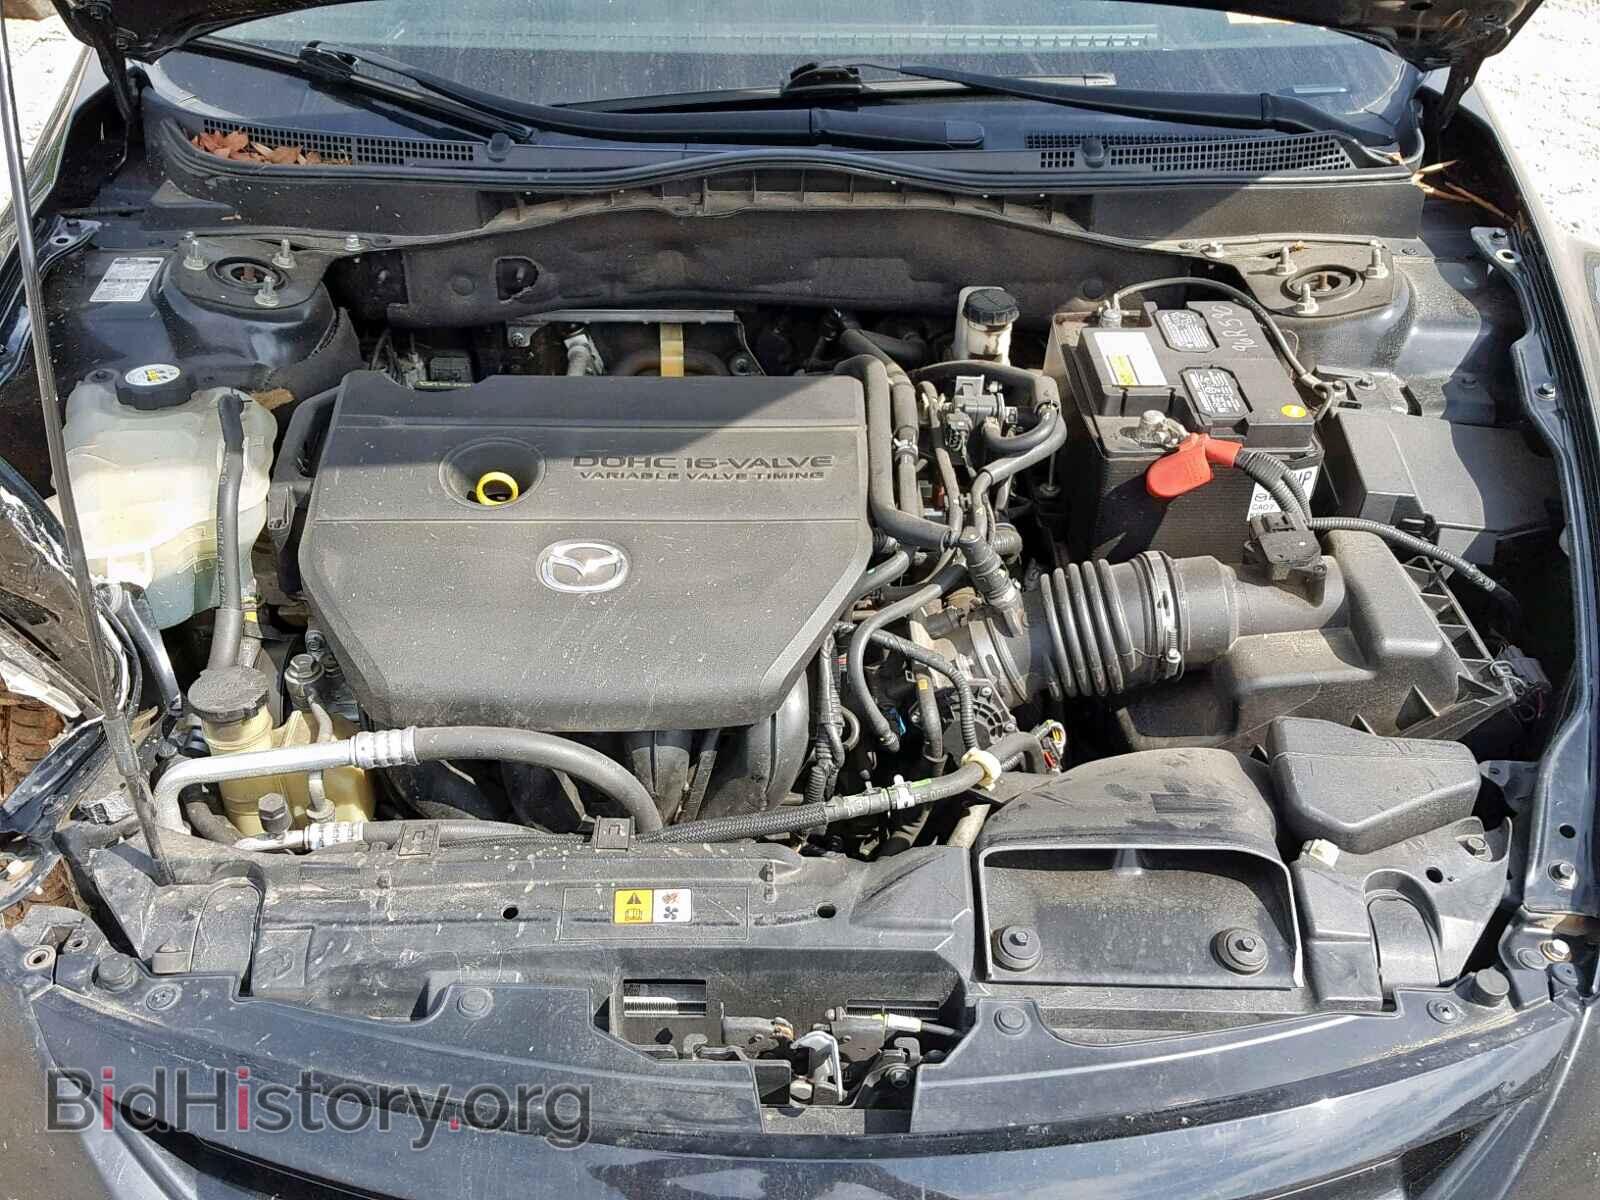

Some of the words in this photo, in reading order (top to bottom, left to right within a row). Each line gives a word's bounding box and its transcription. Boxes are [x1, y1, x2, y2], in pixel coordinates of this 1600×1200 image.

[572, 456, 677, 469] DOHC
[686, 456, 833, 469] 16-VALVE
[580, 471, 680, 480] VARIABLE
[687, 471, 747, 480] VALVE
[755, 471, 825, 480] TIMING
